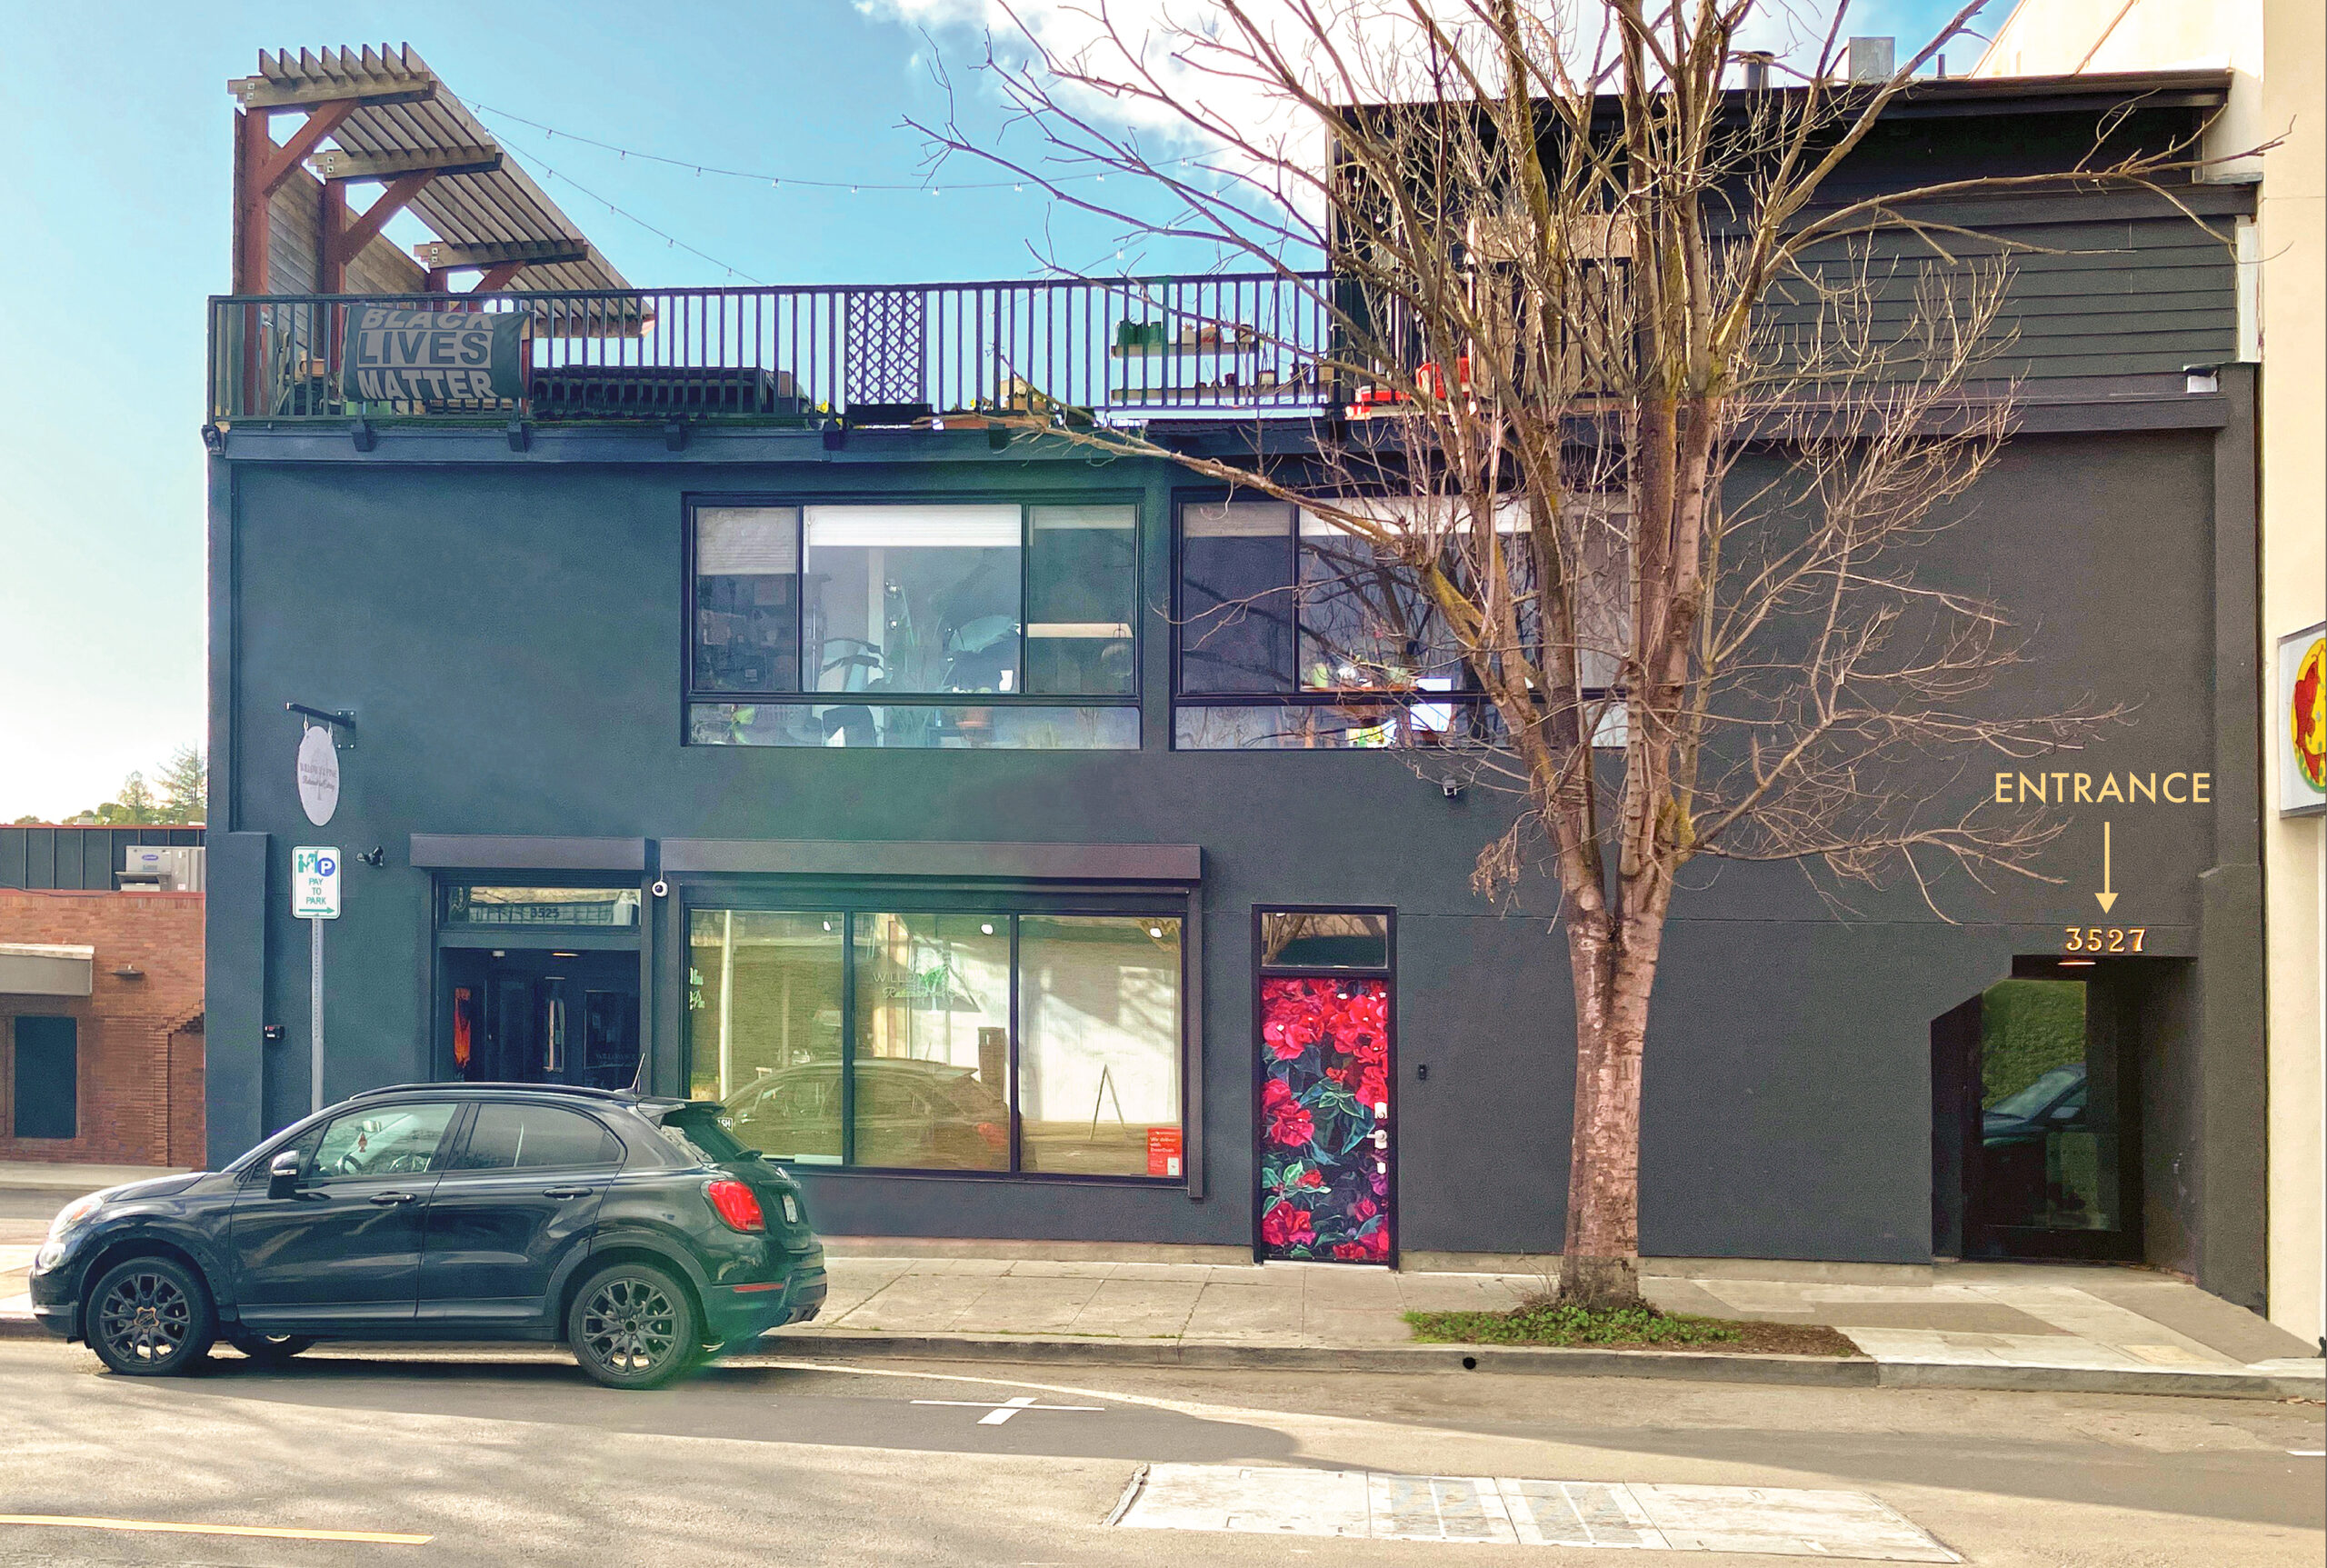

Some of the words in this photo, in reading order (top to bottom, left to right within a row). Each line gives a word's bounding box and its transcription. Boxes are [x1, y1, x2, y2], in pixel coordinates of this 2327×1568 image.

[360, 308, 494, 330] BLACK
[358, 331, 489, 365] LIVES
[357, 370, 498, 400] MATTER
[321, 861, 334, 874] P
[308, 877, 324, 886] PAY
[312, 887, 322, 896] TO
[305, 896, 326, 905] PARK
[2064, 927, 2146, 953] 3527
